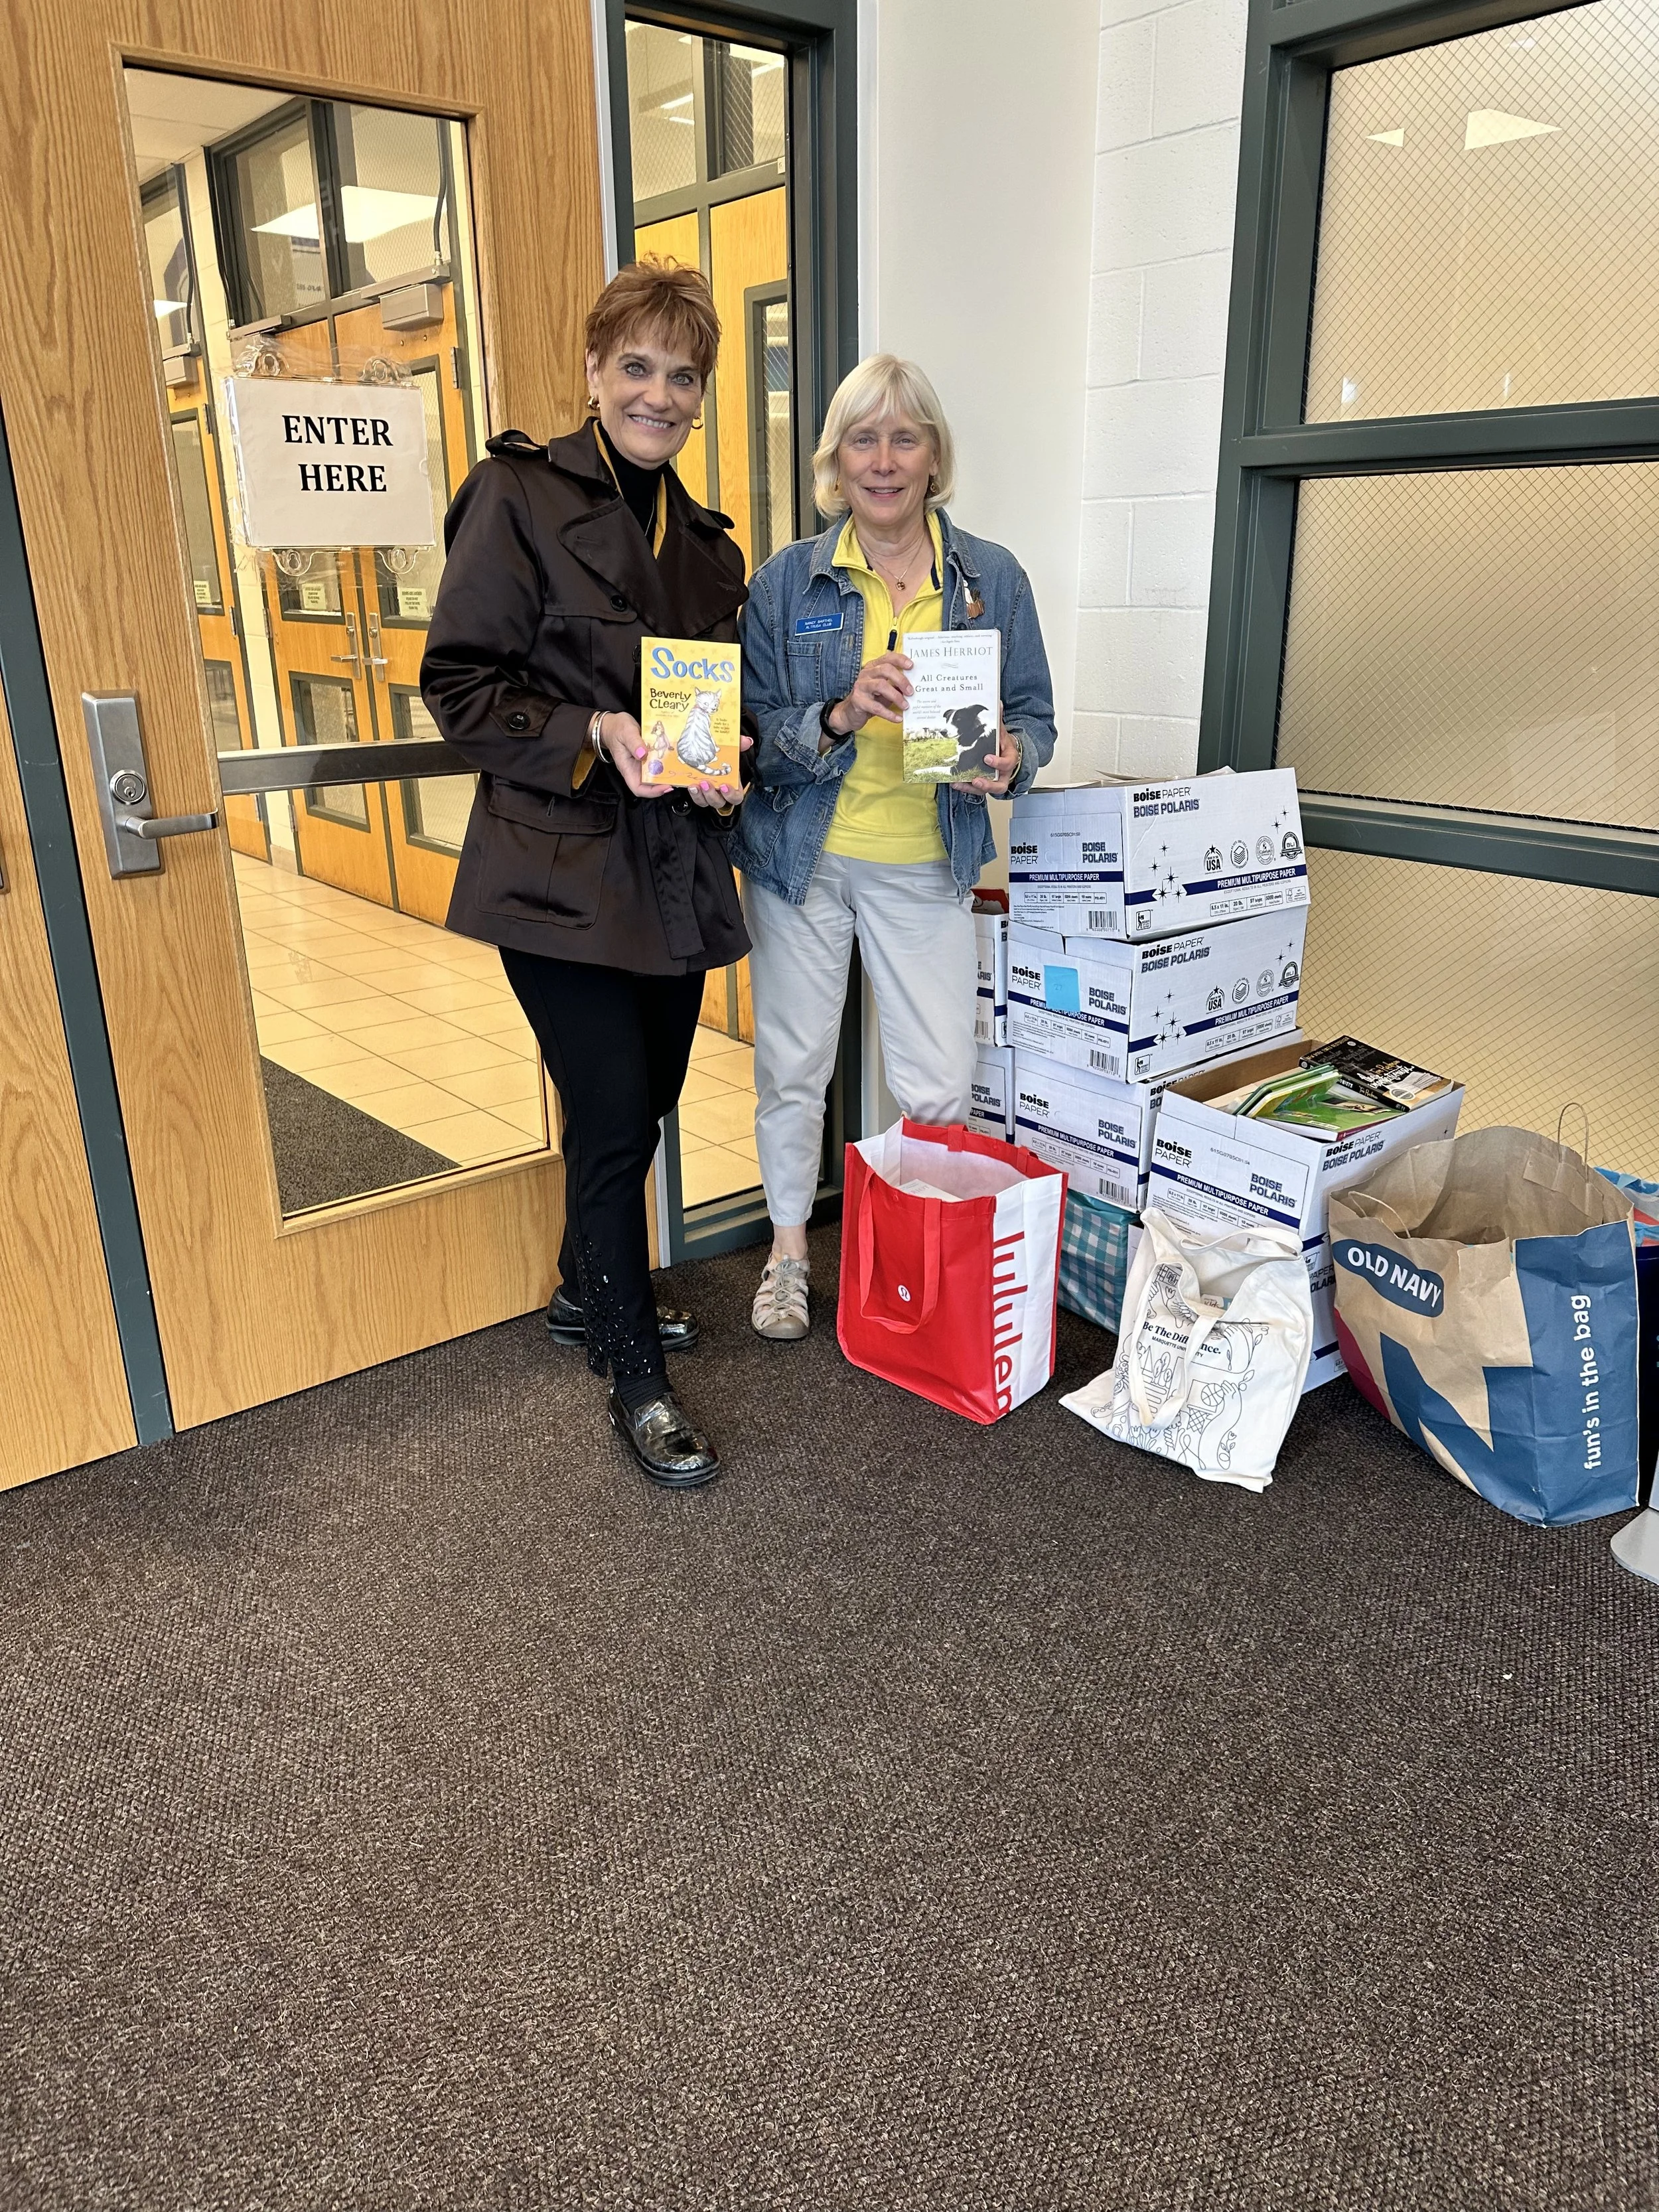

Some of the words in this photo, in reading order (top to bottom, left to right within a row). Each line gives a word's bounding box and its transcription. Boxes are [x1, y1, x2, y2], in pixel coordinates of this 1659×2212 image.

[282, 415, 394, 446] ENTER
[298, 464, 387, 492] HERE
[910, 648, 940, 659] JAMES
[944, 646, 993, 657] HERRIOT
[1163, 787, 1190, 799] PAPER
[1133, 804, 1159, 818] BOISE
[1161, 798, 1199, 814] POLARIS
[1082, 842, 1106, 852] BOISE
[1082, 852, 1118, 863] POLARIS
[1206, 859, 1221, 871] USA
[1217, 878, 1241, 889] PREMIUM
[1242, 872, 1279, 884] MULTIPURPOSE
[1279, 868, 1296, 878] PAPER
[1174, 937, 1202, 952] PAPER
[1141, 956, 1169, 974] BOISE
[1171, 946, 1210, 966] POLARIS
[1011, 976, 1040, 990] PAPER
[1089, 987, 1115, 1001] BOISE
[1030, 998, 1050, 1009] PREMI
[1088, 1016, 1104, 1026] PAPER
[1088, 997, 1126, 1015] POLARIS
[1208, 999, 1222, 1011] USA
[1215, 1013, 1237, 1025] PREMIUM
[1238, 1002, 1273, 1018] MULTIPURPOSE
[1273, 995, 1289, 1007] PAPER
[1019, 1102, 1048, 1118] PAPER
[1098, 1119, 1124, 1135] BOISE
[1038, 1125, 1059, 1138] PREMIUM
[1060, 1132, 1096, 1151] MULTIPURPOSE
[1097, 1146, 1114, 1157] PAPER
[1098, 1129, 1136, 1148] POLARIS
[1354, 1131, 1380, 1147] PAPER
[1155, 1148, 1190, 1168] PAPER
[1322, 1153, 1349, 1171] BOISE
[1349, 1140, 1384, 1163] POLARIS
[1251, 1173, 1283, 1193] BOISE
[1177, 1175, 1203, 1189] PREMIUM
[1203, 1184, 1248, 1208] MULTIPURPOSE
[1248, 1202, 1269, 1216] PAPER
[1250, 1183, 1295, 1208] POLARIS
[1311, 1276, 1336, 1293] OLAR
[1348, 1247, 1389, 1277] OLD
[1390, 1264, 1441, 1307] NAVY
[1571, 1295, 1591, 1341] bag
[1143, 1321, 1153, 1331] Be
[1155, 1325, 1172, 1339] The
[1172, 1333, 1221, 1354] Diffnce.
[1579, 1347, 1599, 1387] the
[1582, 1391, 1599, 1414] in
[1582, 1417, 1602, 1470] fun's
